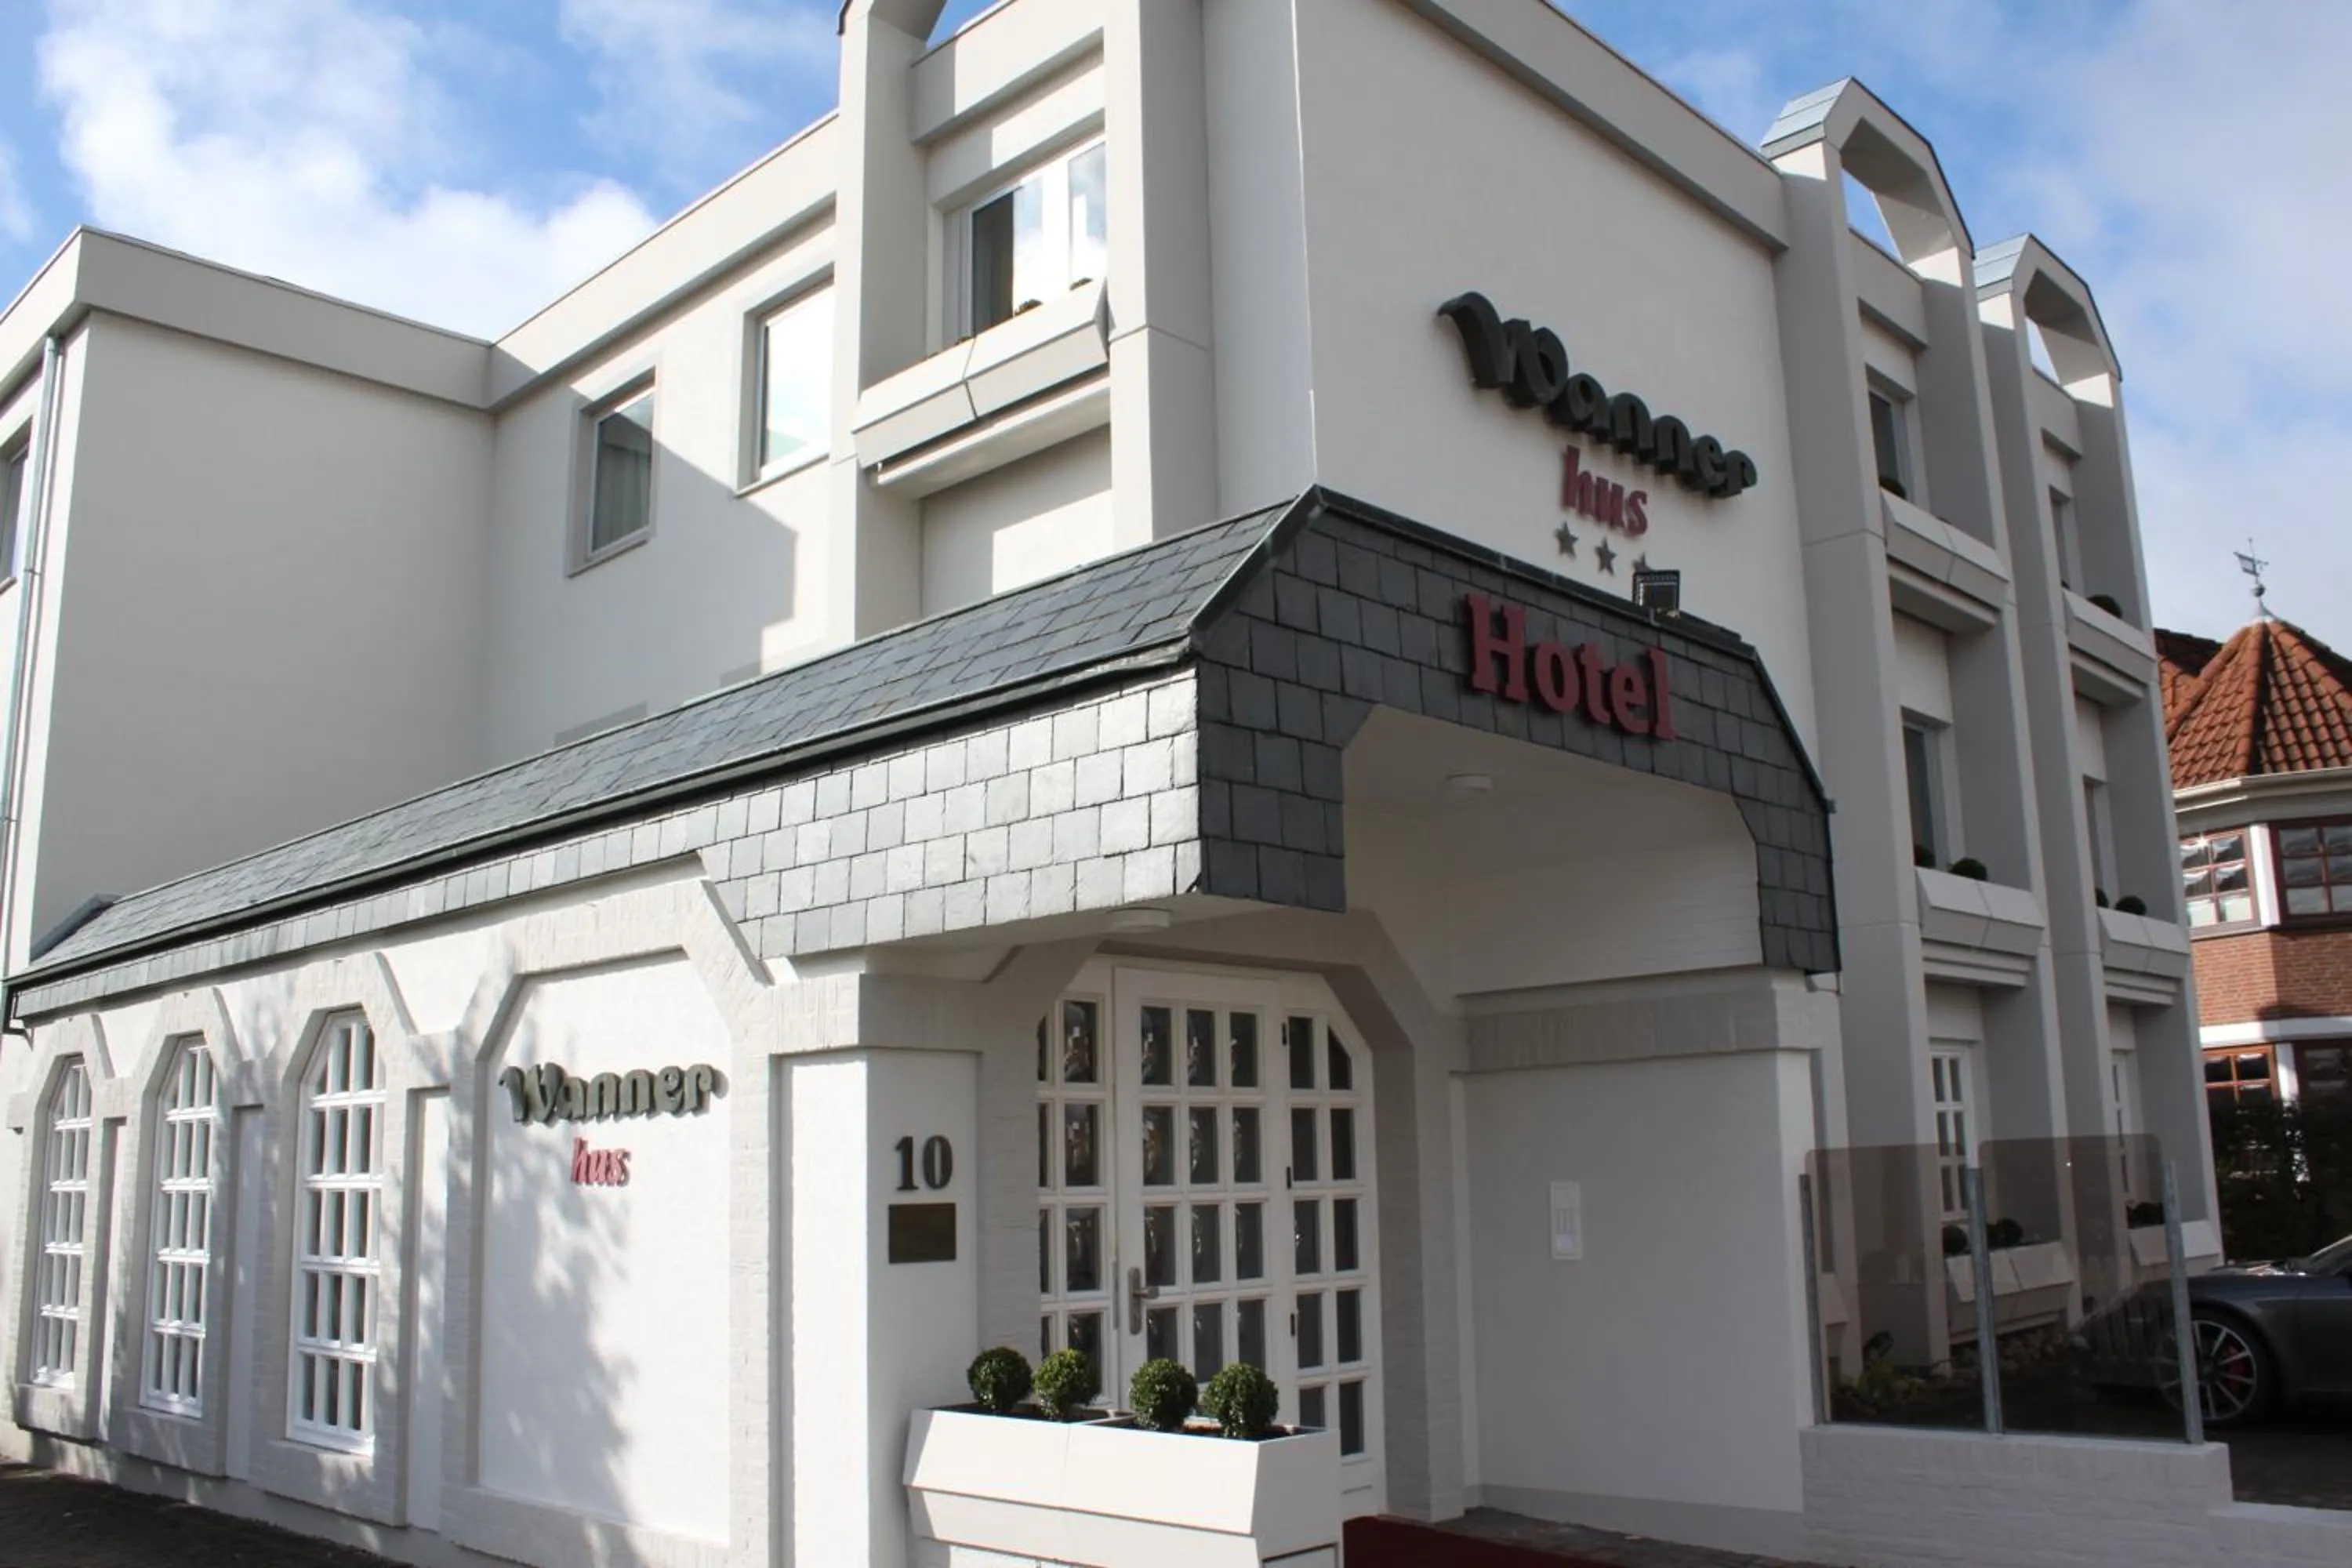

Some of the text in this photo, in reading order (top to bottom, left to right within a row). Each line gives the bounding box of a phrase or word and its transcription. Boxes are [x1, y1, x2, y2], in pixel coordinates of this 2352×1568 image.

[1437, 291, 1757, 499] Wanner
[1562, 445, 1648, 537] hus
[1466, 594, 1677, 740] Hotel
[499, 1062, 723, 1123] Wanner
[572, 1138, 630, 1185] hus
[895, 1134, 953, 1192] 10
